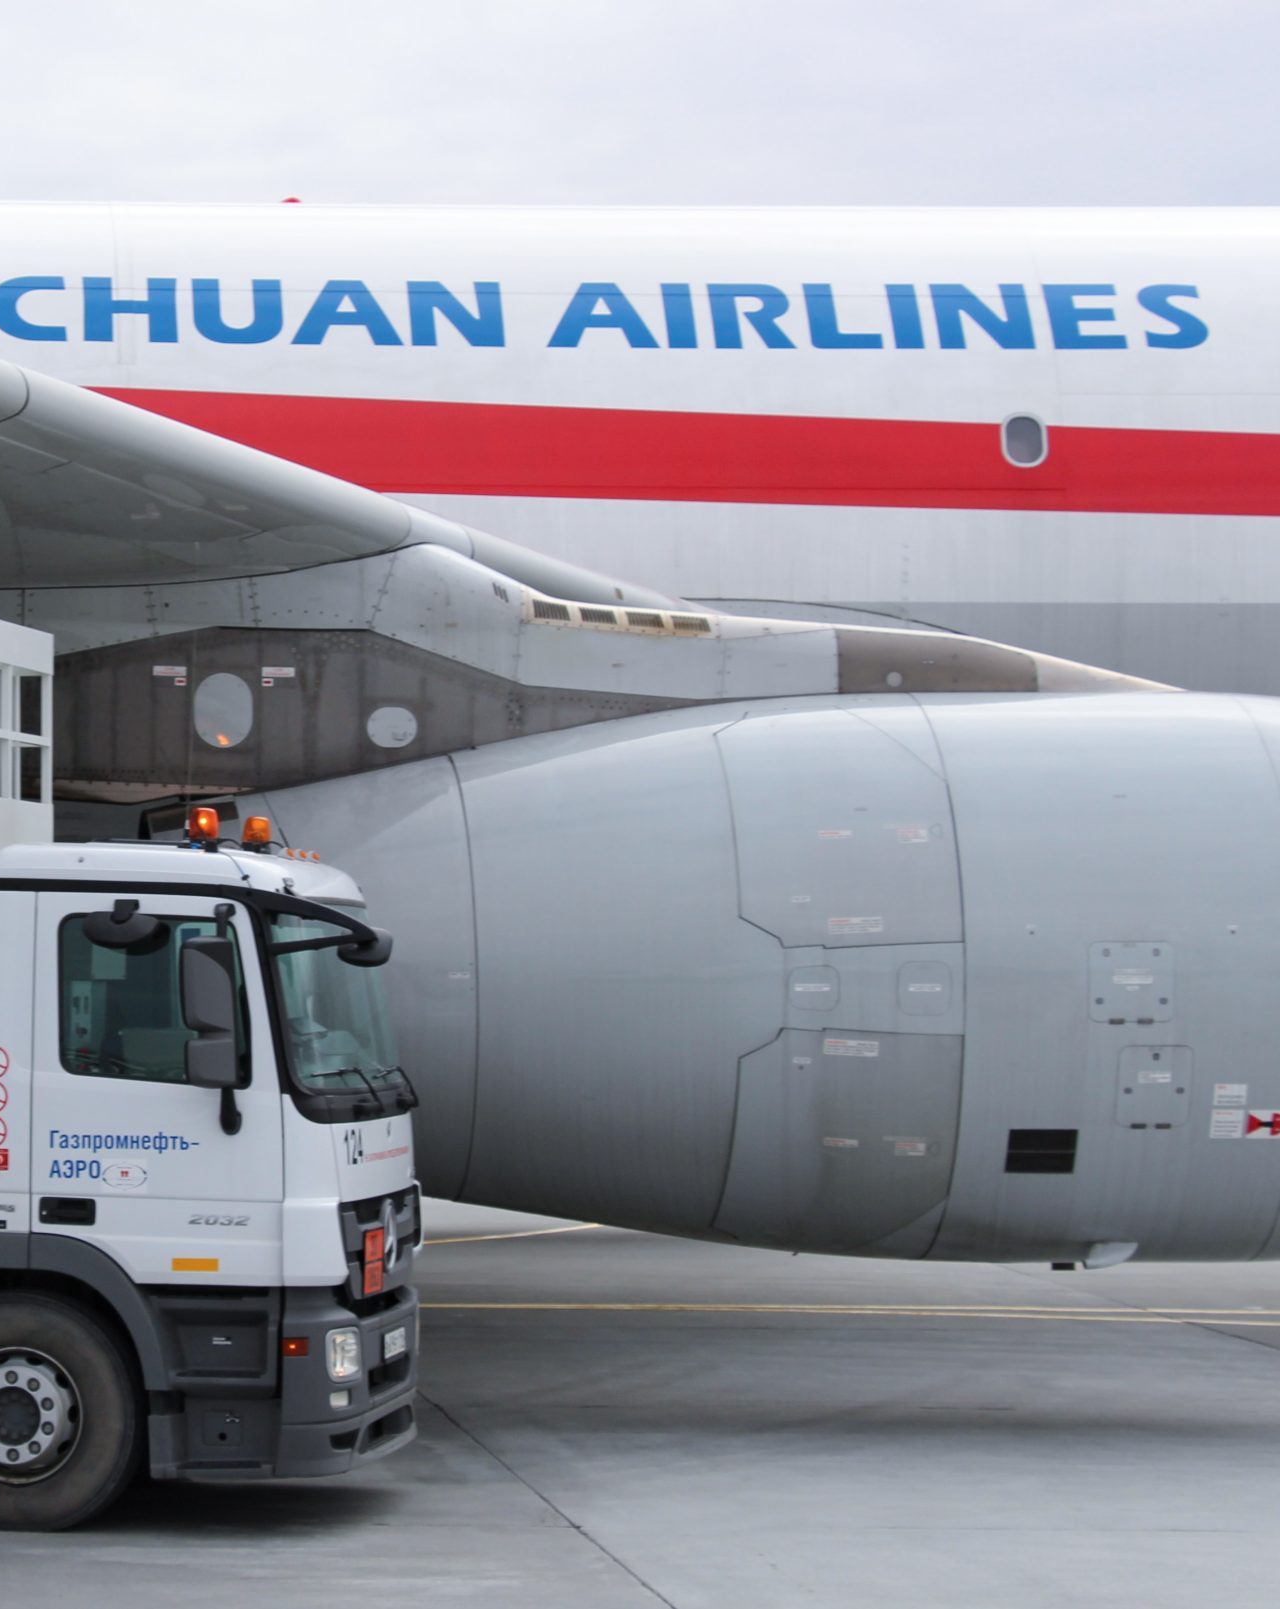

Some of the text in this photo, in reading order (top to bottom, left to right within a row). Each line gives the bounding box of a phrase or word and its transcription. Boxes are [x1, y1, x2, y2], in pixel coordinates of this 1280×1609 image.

[546, 281, 1210, 350] AIRLINES
[343, 1128, 364, 1165] 124
[49, 1159, 102, 1180] АЭРО
[188, 1214, 251, 1227] 2032
